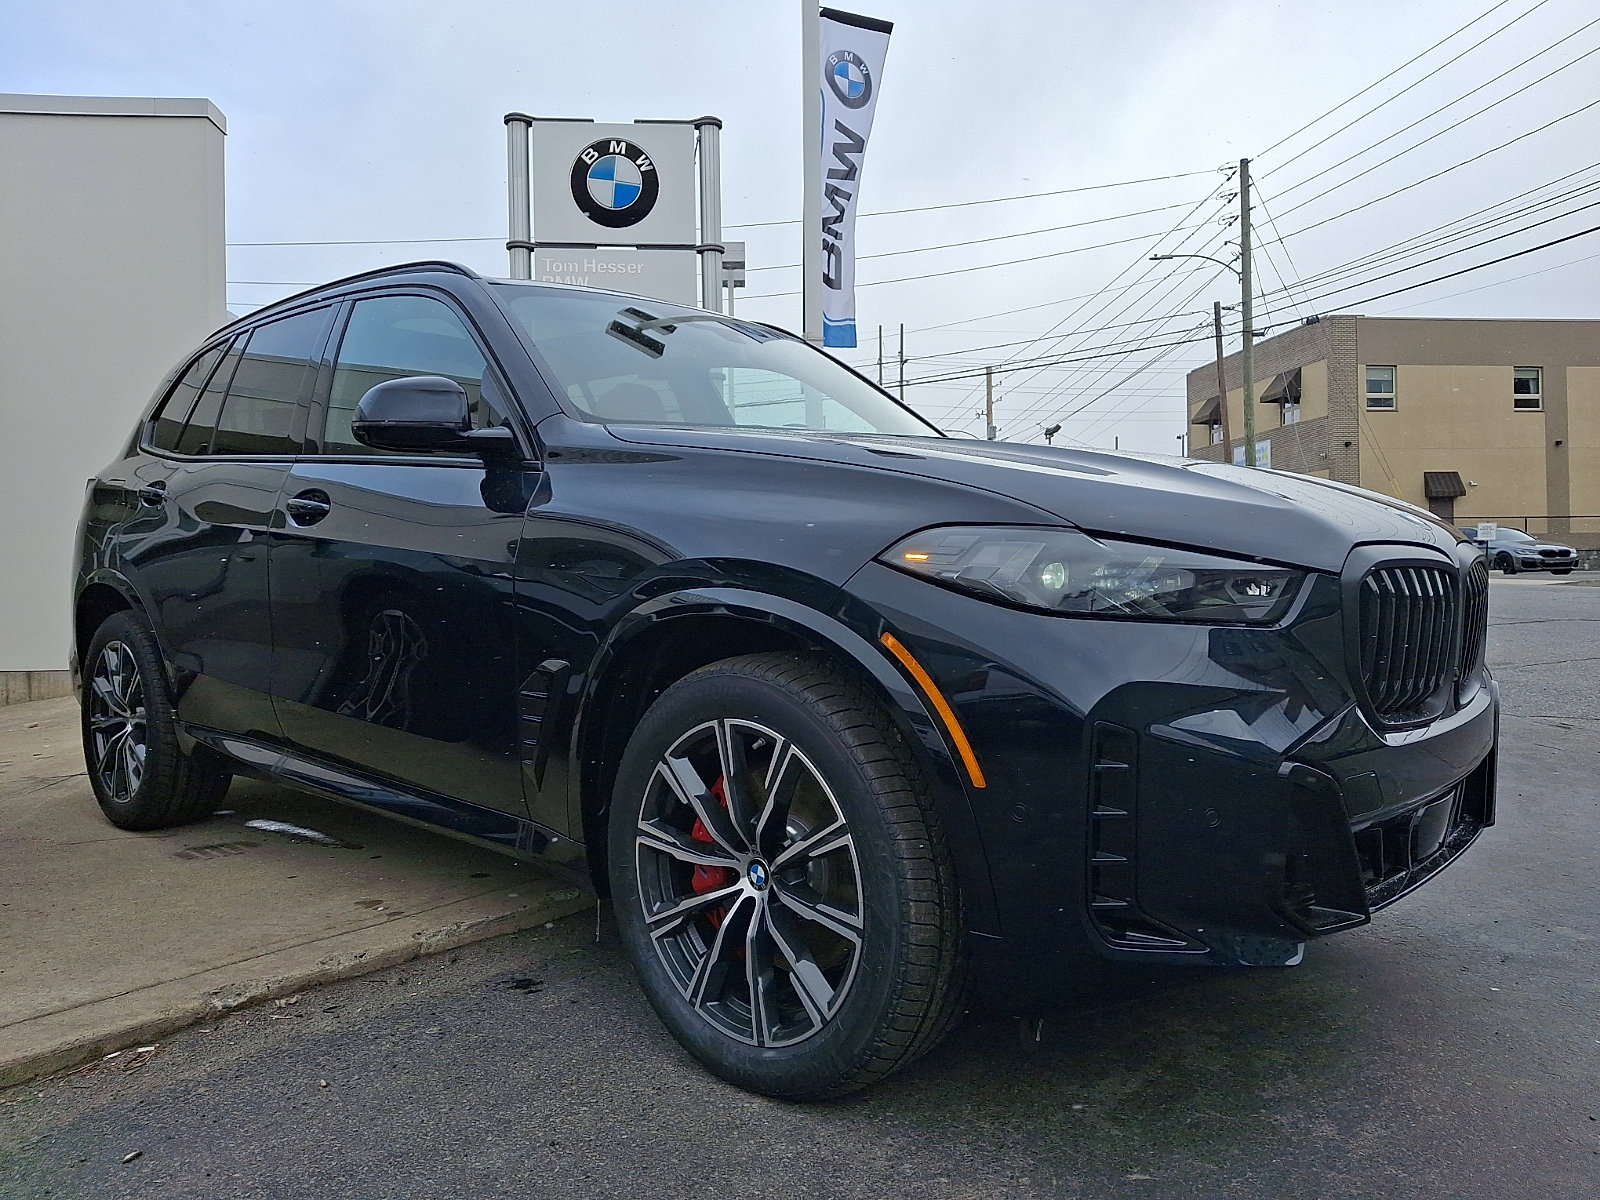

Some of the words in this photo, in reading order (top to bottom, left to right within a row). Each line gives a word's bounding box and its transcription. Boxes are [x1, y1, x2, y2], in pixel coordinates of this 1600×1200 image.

[829, 51, 869, 74] BMW
[581, 140, 654, 172] BMW
[822, 118, 866, 290] BMW
[542, 258, 579, 272] Tom
[583, 259, 644, 274] Hesser
